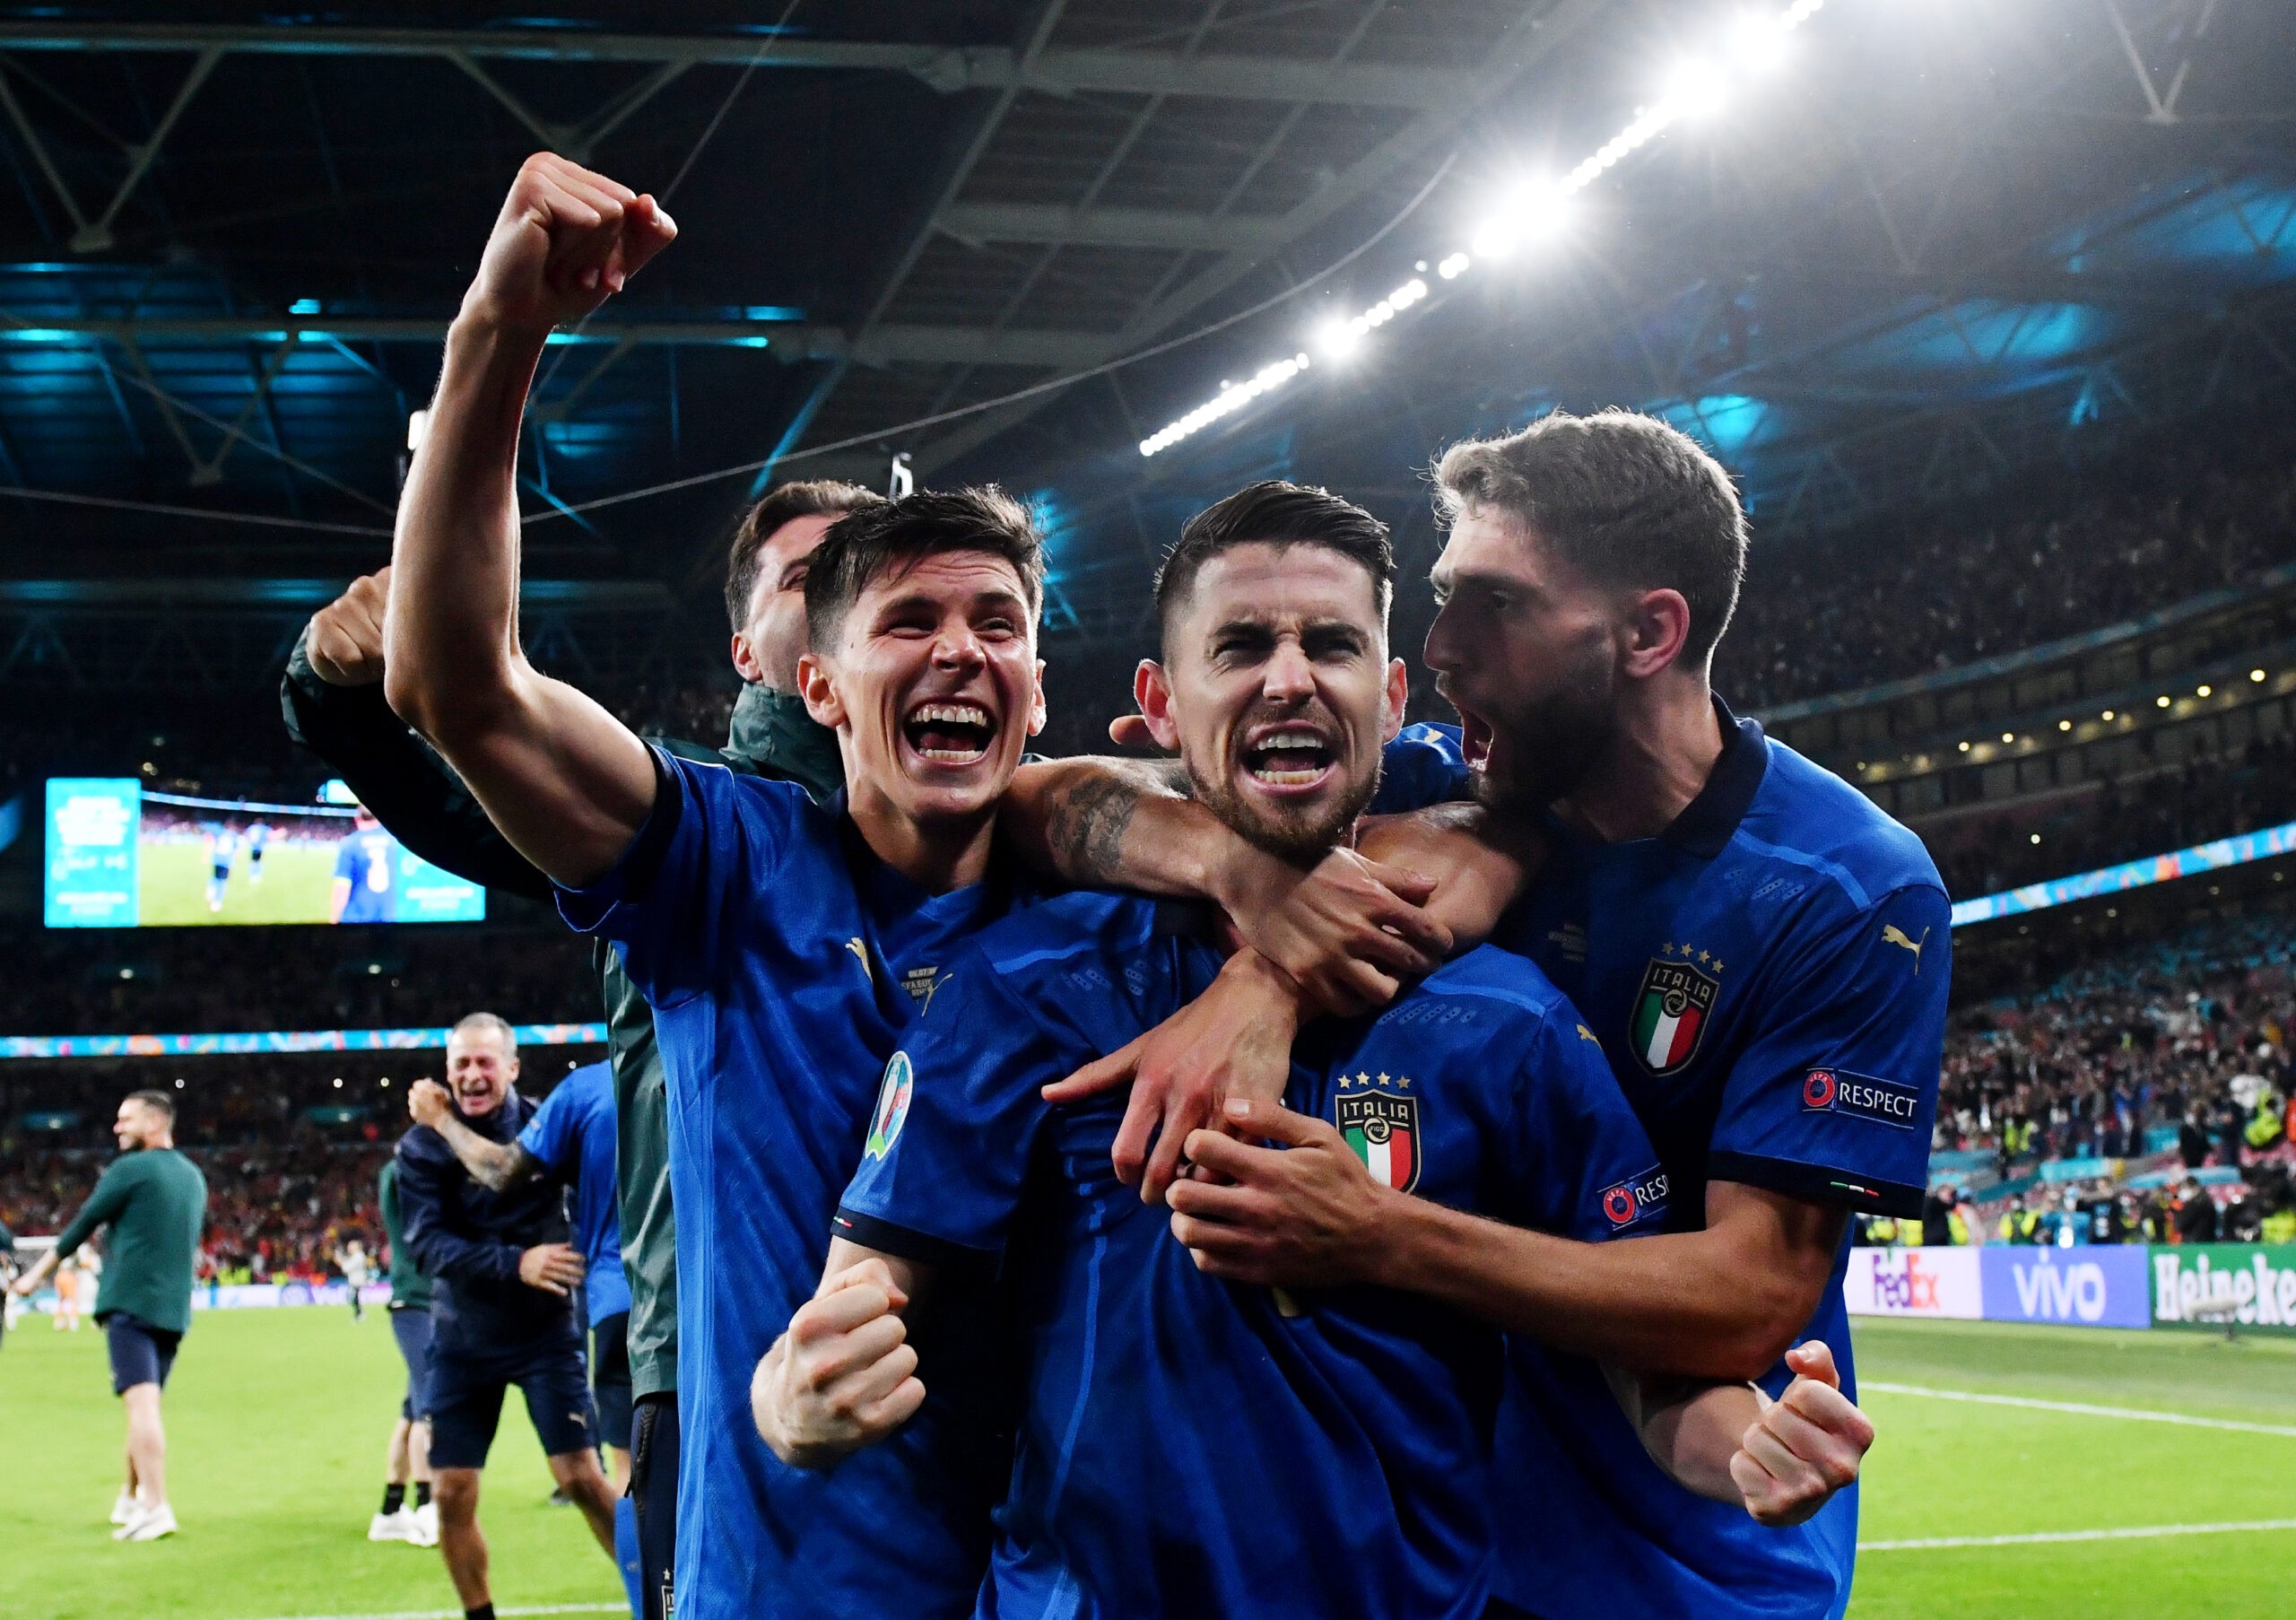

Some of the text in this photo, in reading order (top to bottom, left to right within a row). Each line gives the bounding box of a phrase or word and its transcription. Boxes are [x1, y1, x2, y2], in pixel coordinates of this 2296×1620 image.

[1652, 968, 1711, 1002] ITALIA
[1343, 1101, 1409, 1120] ITALIA
[1839, 1082, 1918, 1118] RESPECT
[1370, 1125, 1385, 1133] FIGC
[1606, 1189, 1625, 1203] UEFA
[1873, 1252, 1941, 1310] FedEx
[2012, 1245, 2107, 1321] vivo
